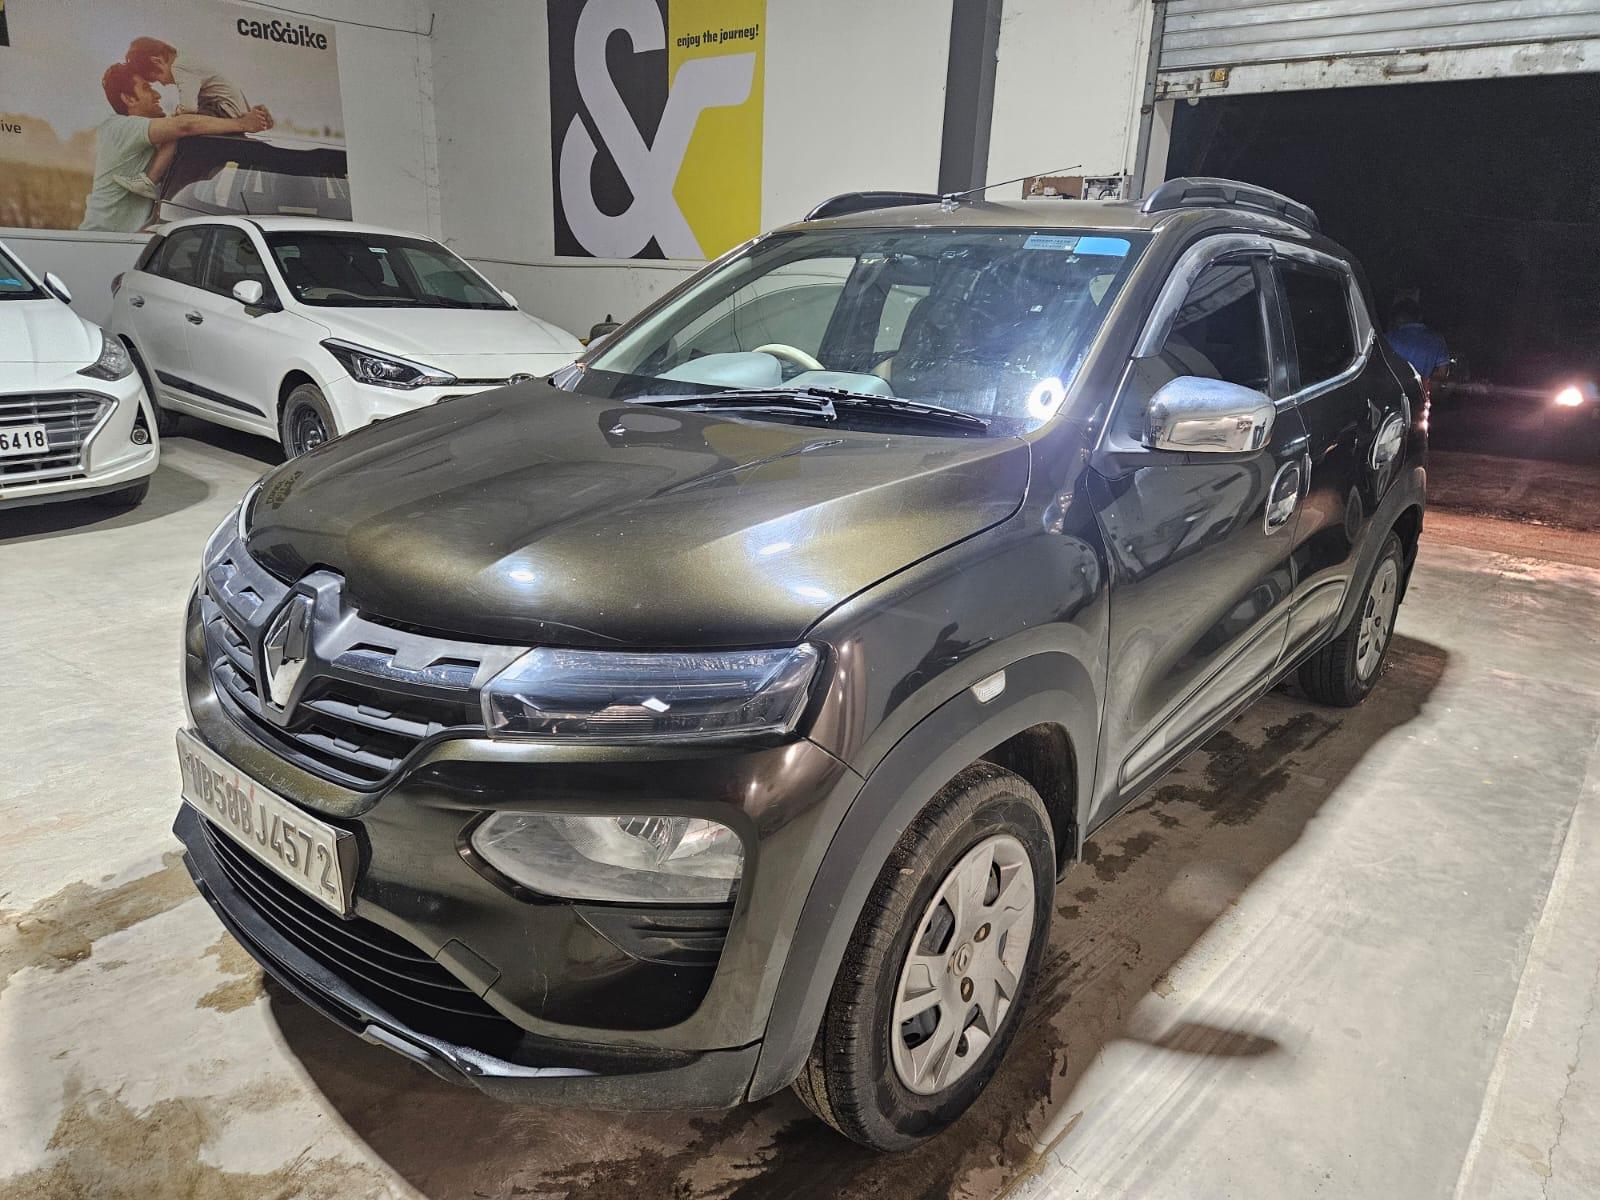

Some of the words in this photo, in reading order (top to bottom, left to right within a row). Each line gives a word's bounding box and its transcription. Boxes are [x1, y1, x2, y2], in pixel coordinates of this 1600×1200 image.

[237, 18, 328, 50] car&bike
[677, 33, 701, 48] enjoy
[702, 30, 718, 43] the
[719, 23, 759, 44] journey!
[0, 431, 45, 450] 6418
